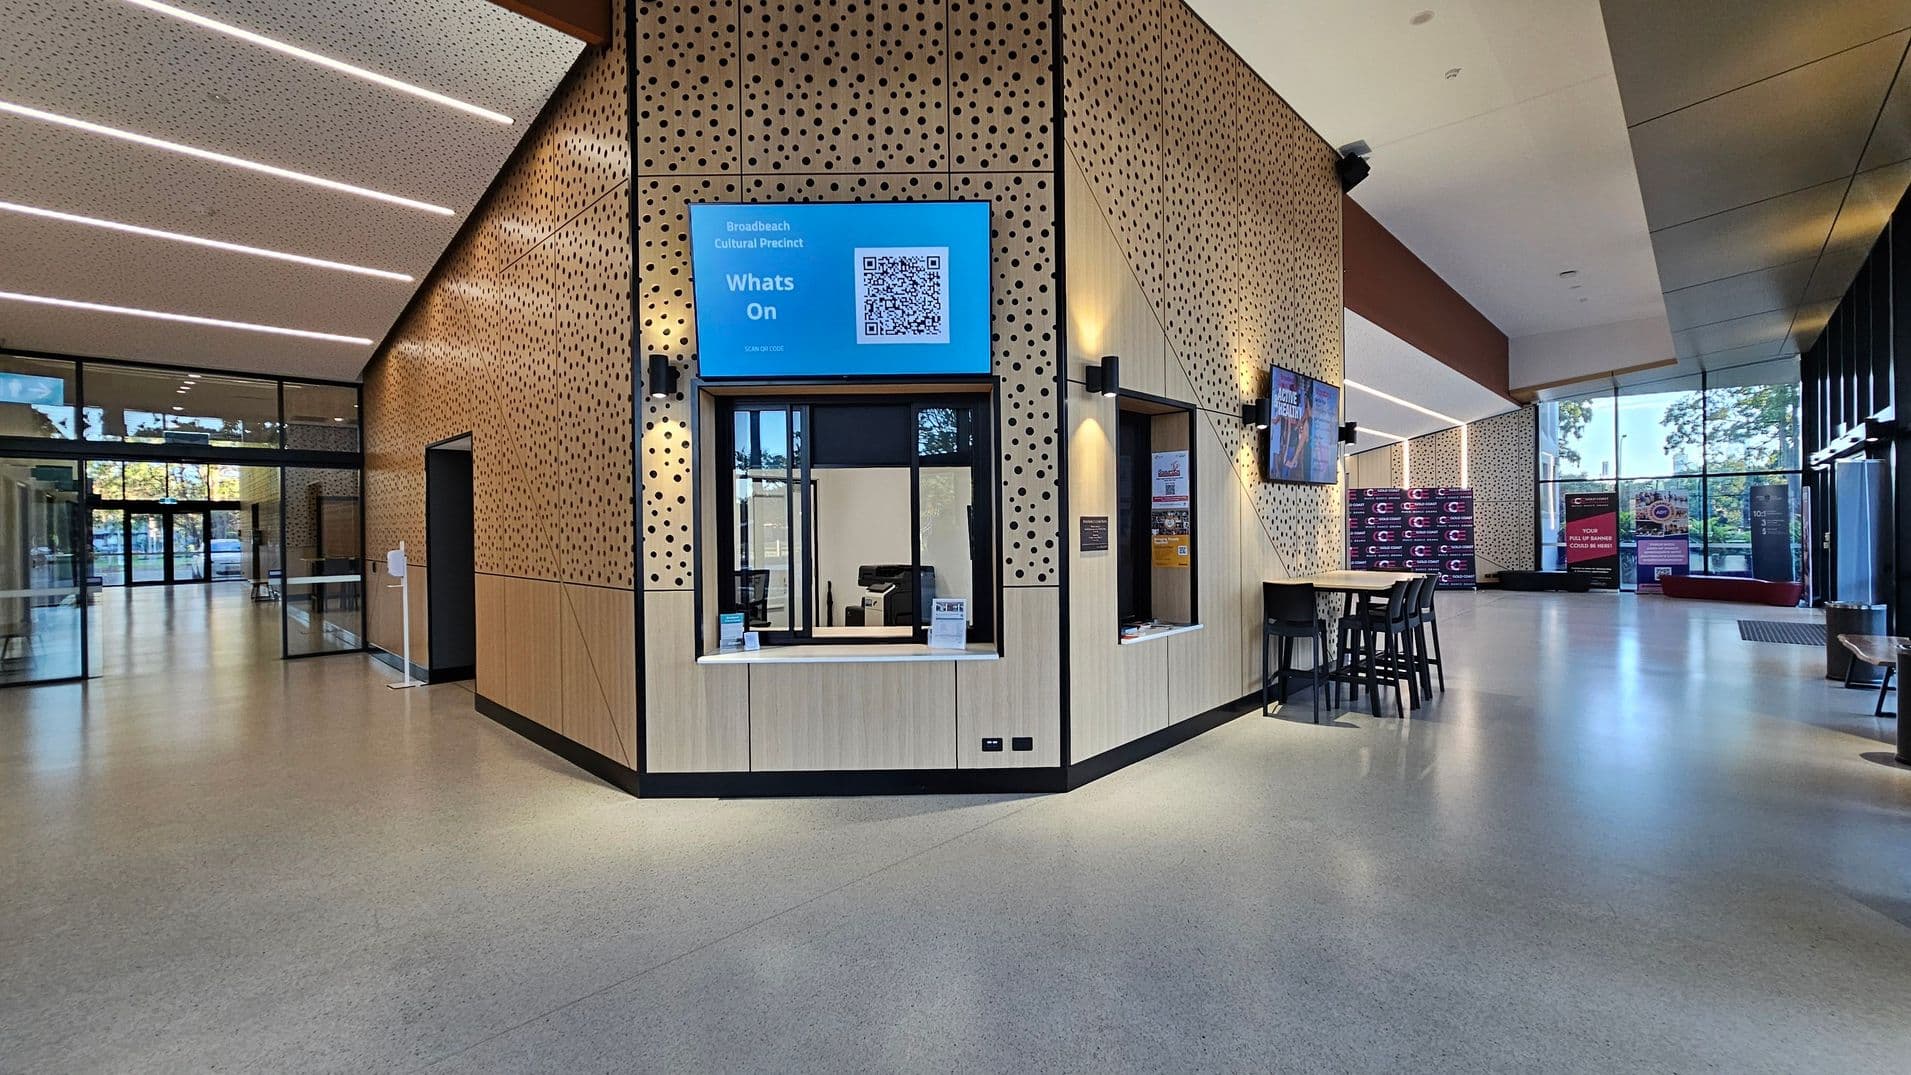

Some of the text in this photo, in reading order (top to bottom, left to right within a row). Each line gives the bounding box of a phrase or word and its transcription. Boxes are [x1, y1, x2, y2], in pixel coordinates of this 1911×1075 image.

[726, 220, 791, 232] Broadbeach
[714, 237, 804, 249] Cultural Precinct
[726, 272, 794, 291] Whats
[746, 302, 777, 320] On
[1278, 388, 1298, 405] ACTIVE
[1278, 401, 1302, 420] HEALTHY
